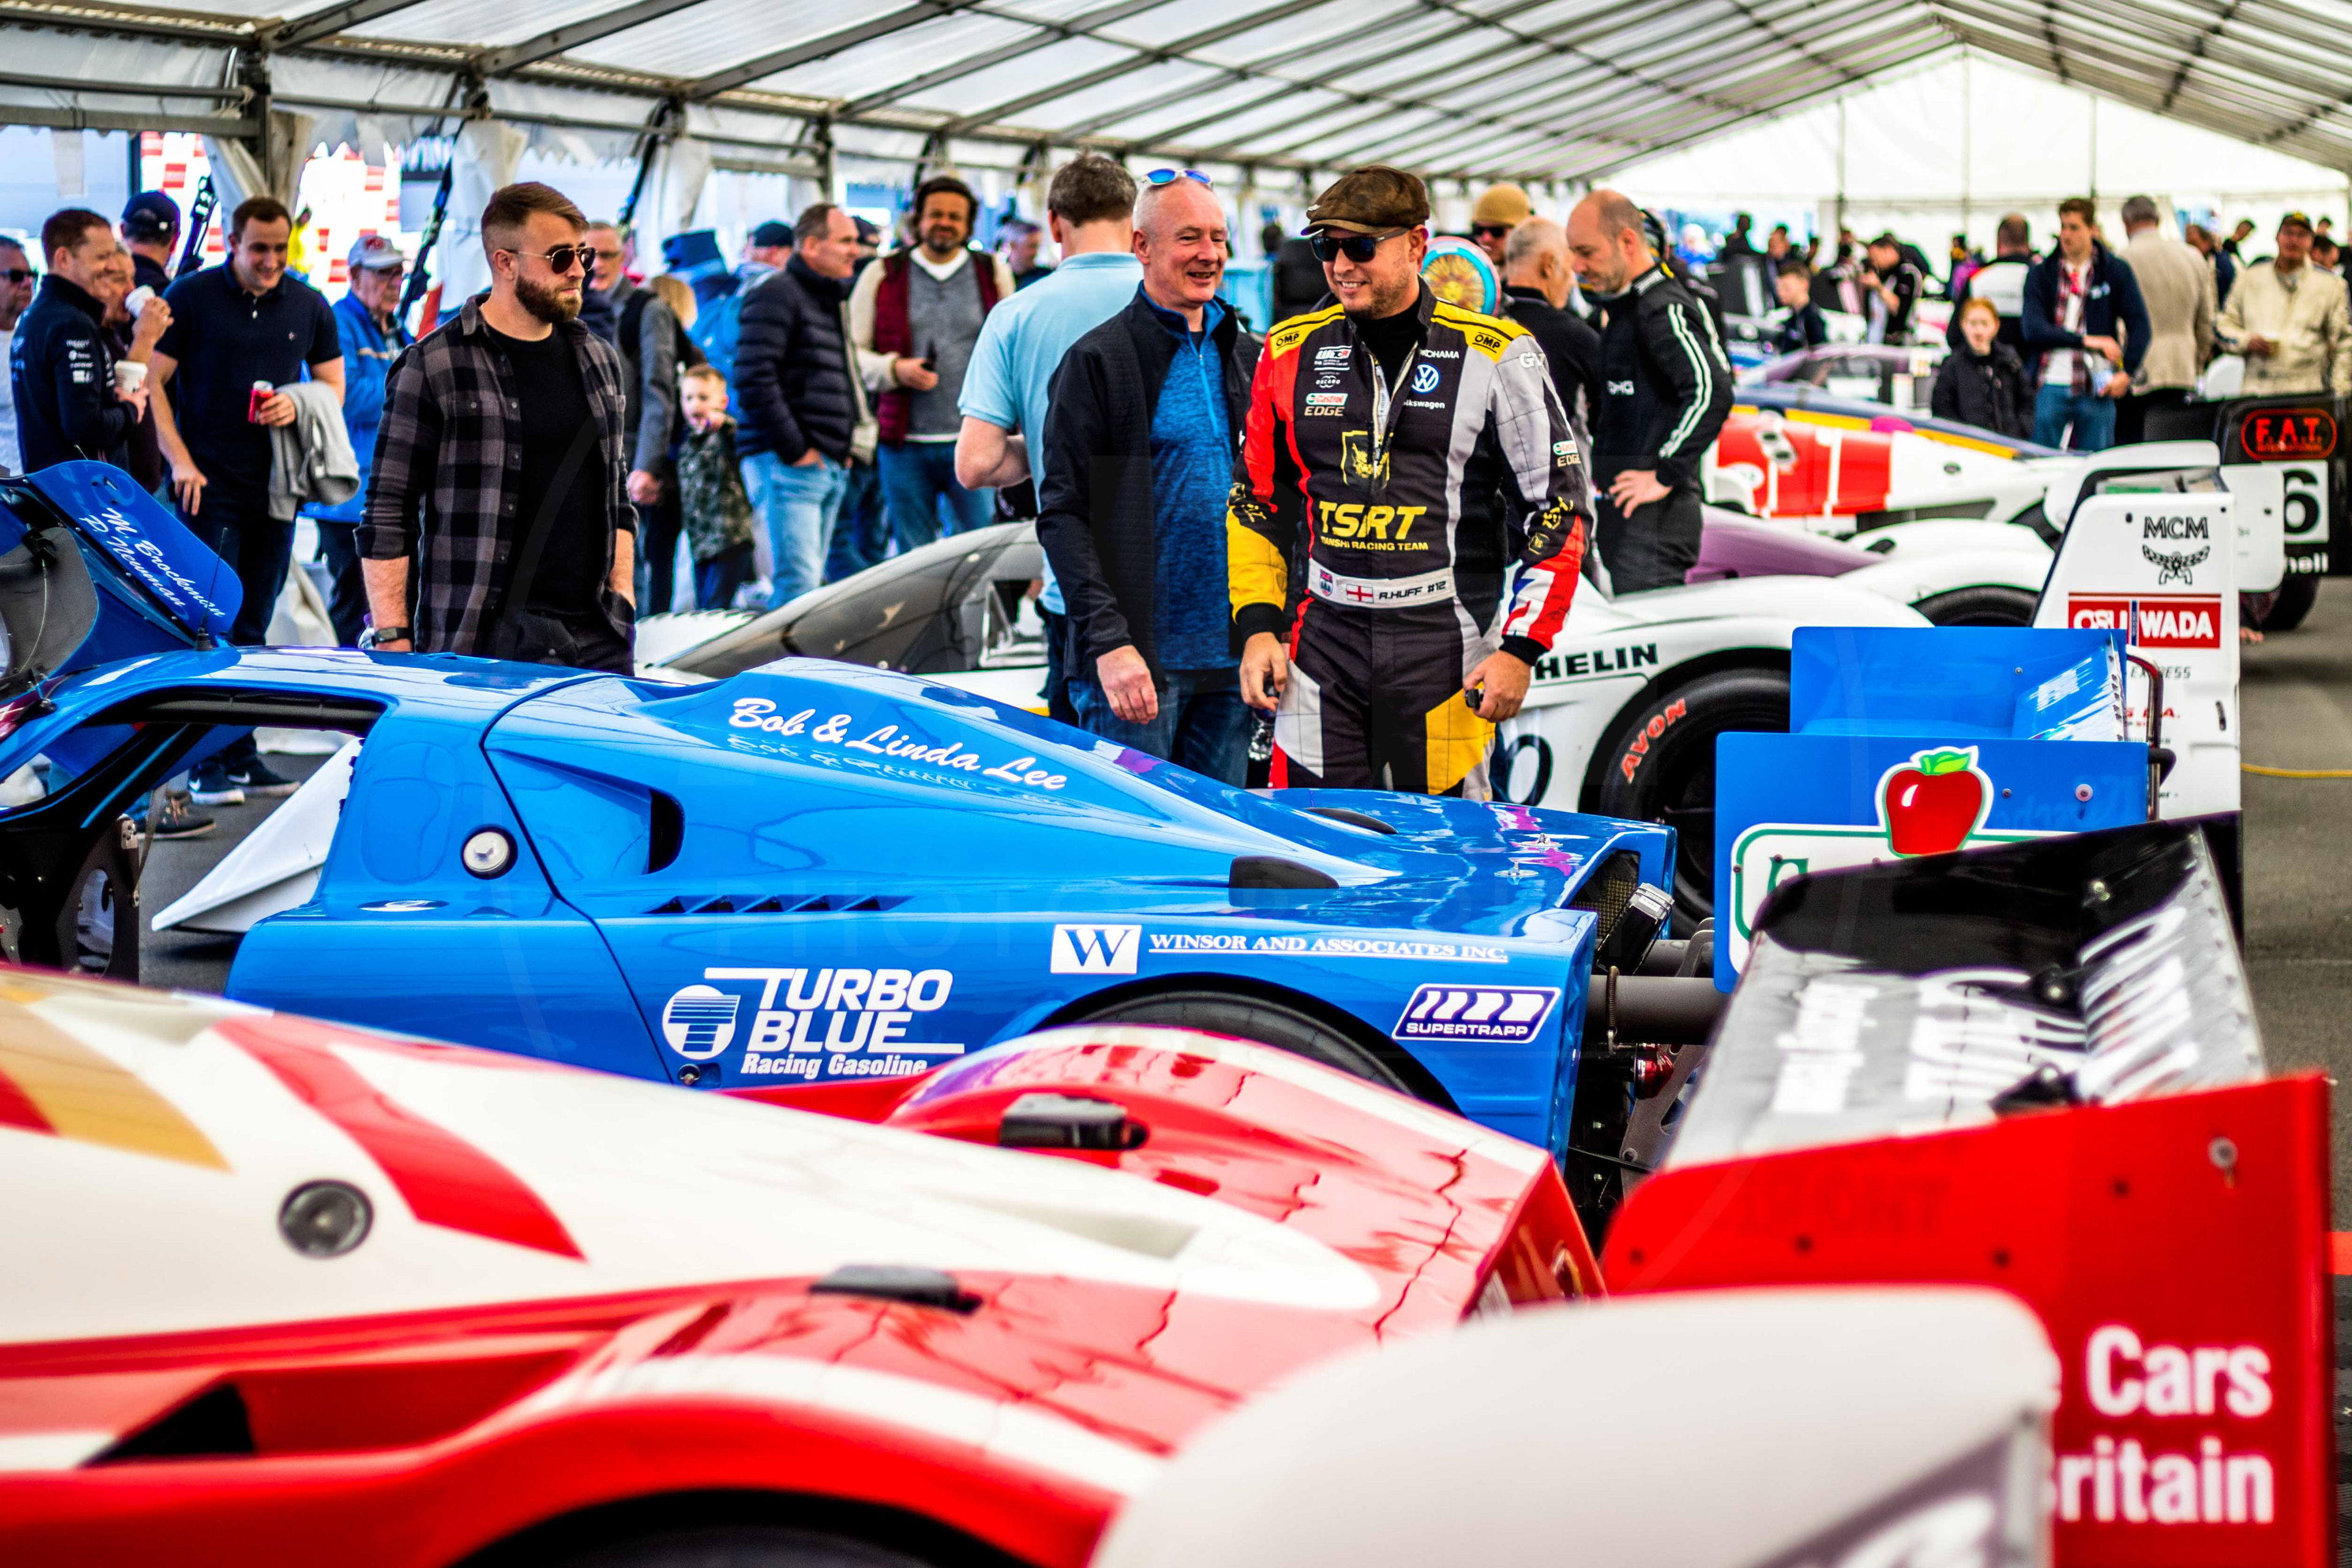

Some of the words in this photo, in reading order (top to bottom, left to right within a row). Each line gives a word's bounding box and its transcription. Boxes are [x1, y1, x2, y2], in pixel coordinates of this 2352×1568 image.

[1276, 333, 1300, 346] OMP
[1475, 334, 1501, 349] OMP
[1304, 406, 1345, 416] EDGE
[1557, 454, 1581, 467] EDGE
[2282, 468, 2321, 536] 6
[1319, 500, 1427, 540] TSRT
[2143, 516, 2209, 539] MCM
[1351, 541, 1395, 551] RACING
[1396, 542, 1429, 551] TEAM
[106, 535, 186, 608] Newman
[134, 540, 225, 617] Brockman
[1427, 581, 1446, 594] #12
[2139, 609, 2215, 639] WADA
[728, 697, 816, 736] Bob
[812, 714, 852, 744] &
[845, 725, 981, 771] Linda
[982, 756, 1068, 790] Lee
[1621, 698, 1687, 785] AVON
[1150, 933, 1247, 950] WINSOR
[1252, 936, 1309, 951] AND
[1312, 938, 1455, 957] ASSOCIATES
[1461, 945, 1509, 960] INC.
[704, 967, 953, 1011] TURBO
[746, 1011, 965, 1054] BLUE
[1405, 1022, 1529, 1036] SUPERTRAPP
[740, 1053, 823, 1079] Racing
[827, 1054, 928, 1076] Gasoline
[2085, 1323, 2273, 1418] Cars
[2053, 1433, 2275, 1525] ritain
